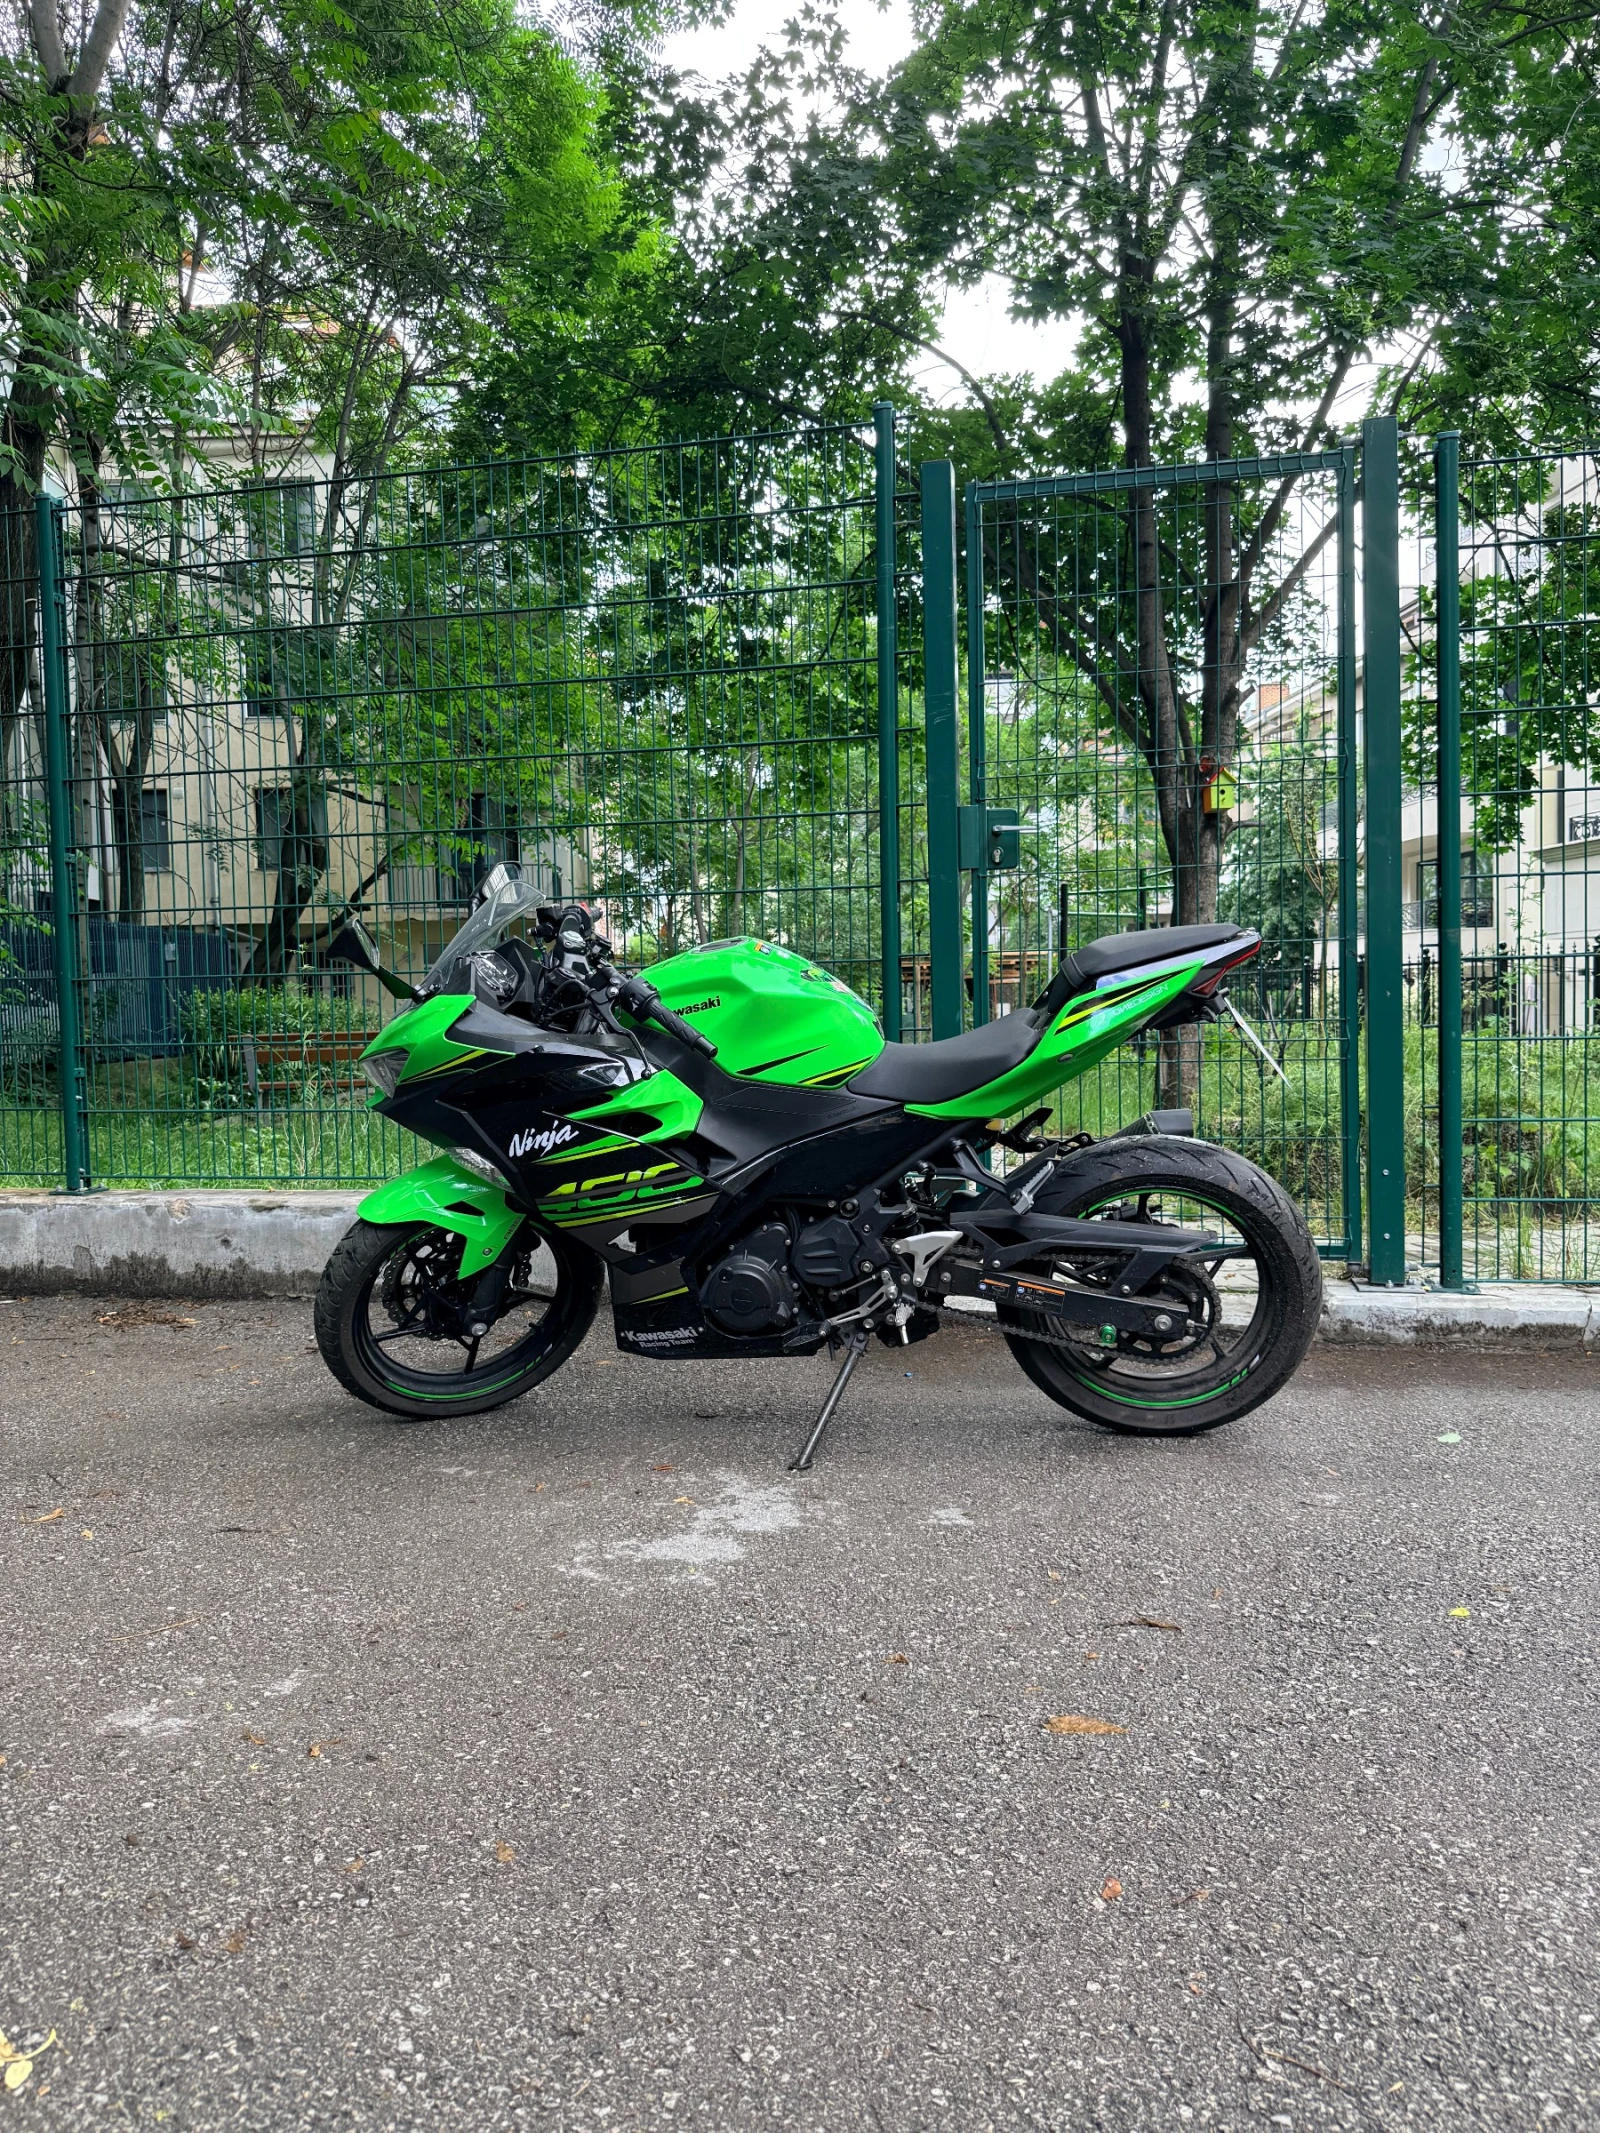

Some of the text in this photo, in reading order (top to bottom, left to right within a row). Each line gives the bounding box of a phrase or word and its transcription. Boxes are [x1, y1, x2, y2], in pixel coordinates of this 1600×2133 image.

[673, 995, 721, 1016] wasaki
[508, 1119, 580, 1158] Ninja
[537, 1161, 705, 1212] 400
[624, 1326, 699, 1342] Kawasaki
[639, 1338, 695, 1348] Racing Team
